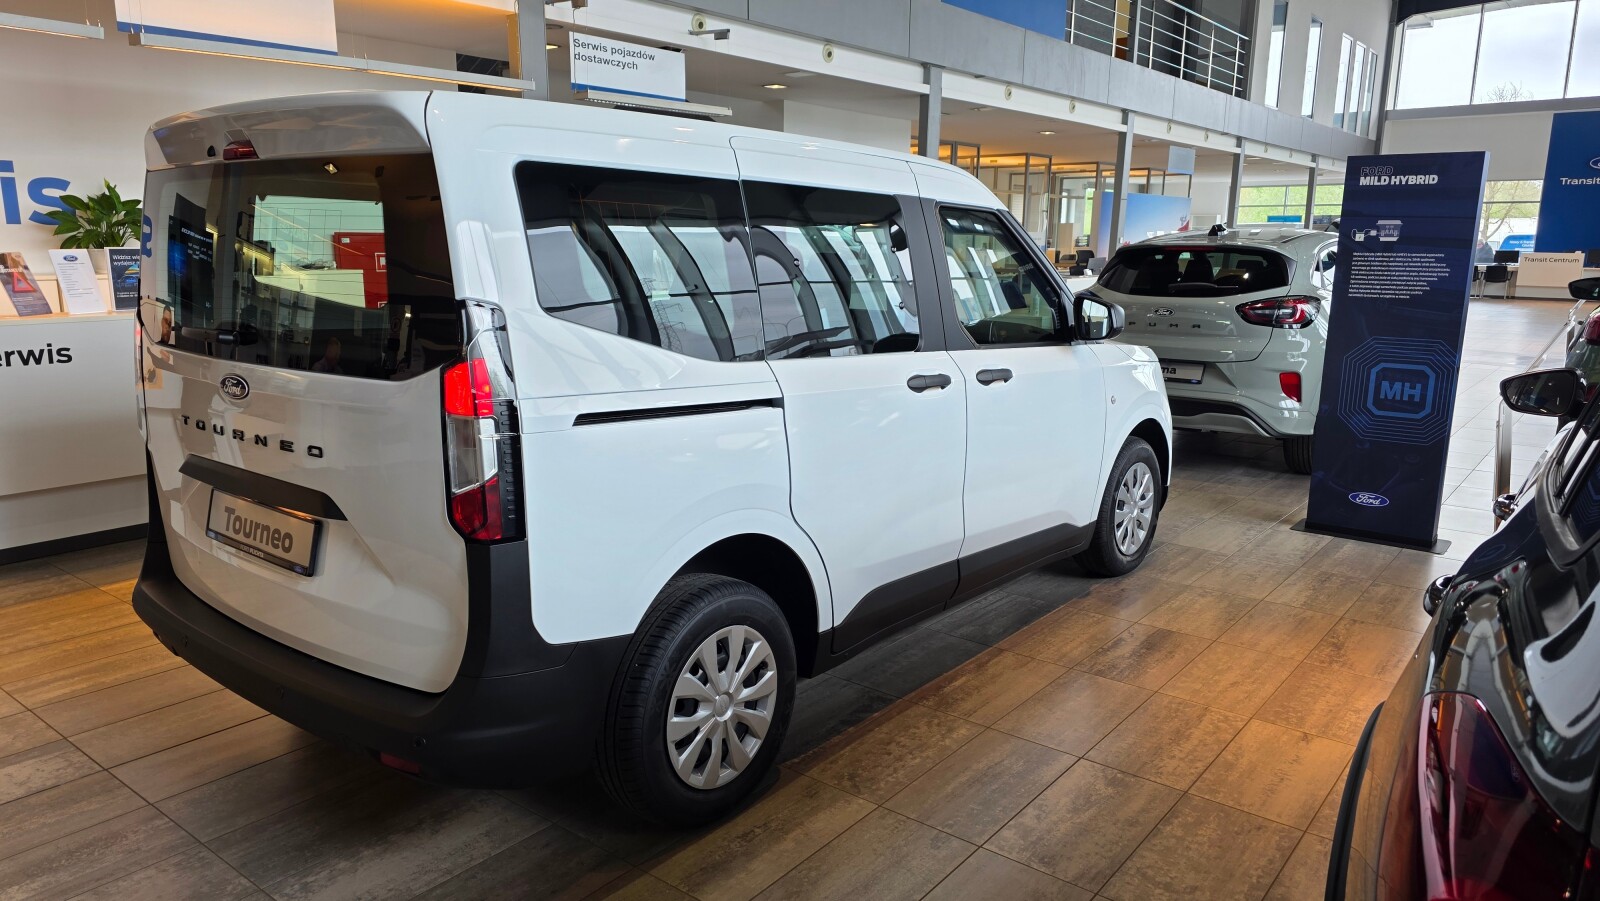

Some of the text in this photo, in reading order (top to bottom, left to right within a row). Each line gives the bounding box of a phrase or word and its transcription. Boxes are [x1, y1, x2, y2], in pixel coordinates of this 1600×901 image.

[573, 38, 656, 61] Serwis pojazdów
[574, 52, 638, 71] dostawczych
[1359, 174, 1438, 186] MILD HYBRID
[1360, 166, 1394, 176] FORD
[1128, 321, 1201, 329] PUMA
[0, 342, 73, 367] rwis
[1380, 380, 1422, 402] MH
[182, 414, 324, 459] TOURNEO
[224, 505, 294, 554] Tourneo
